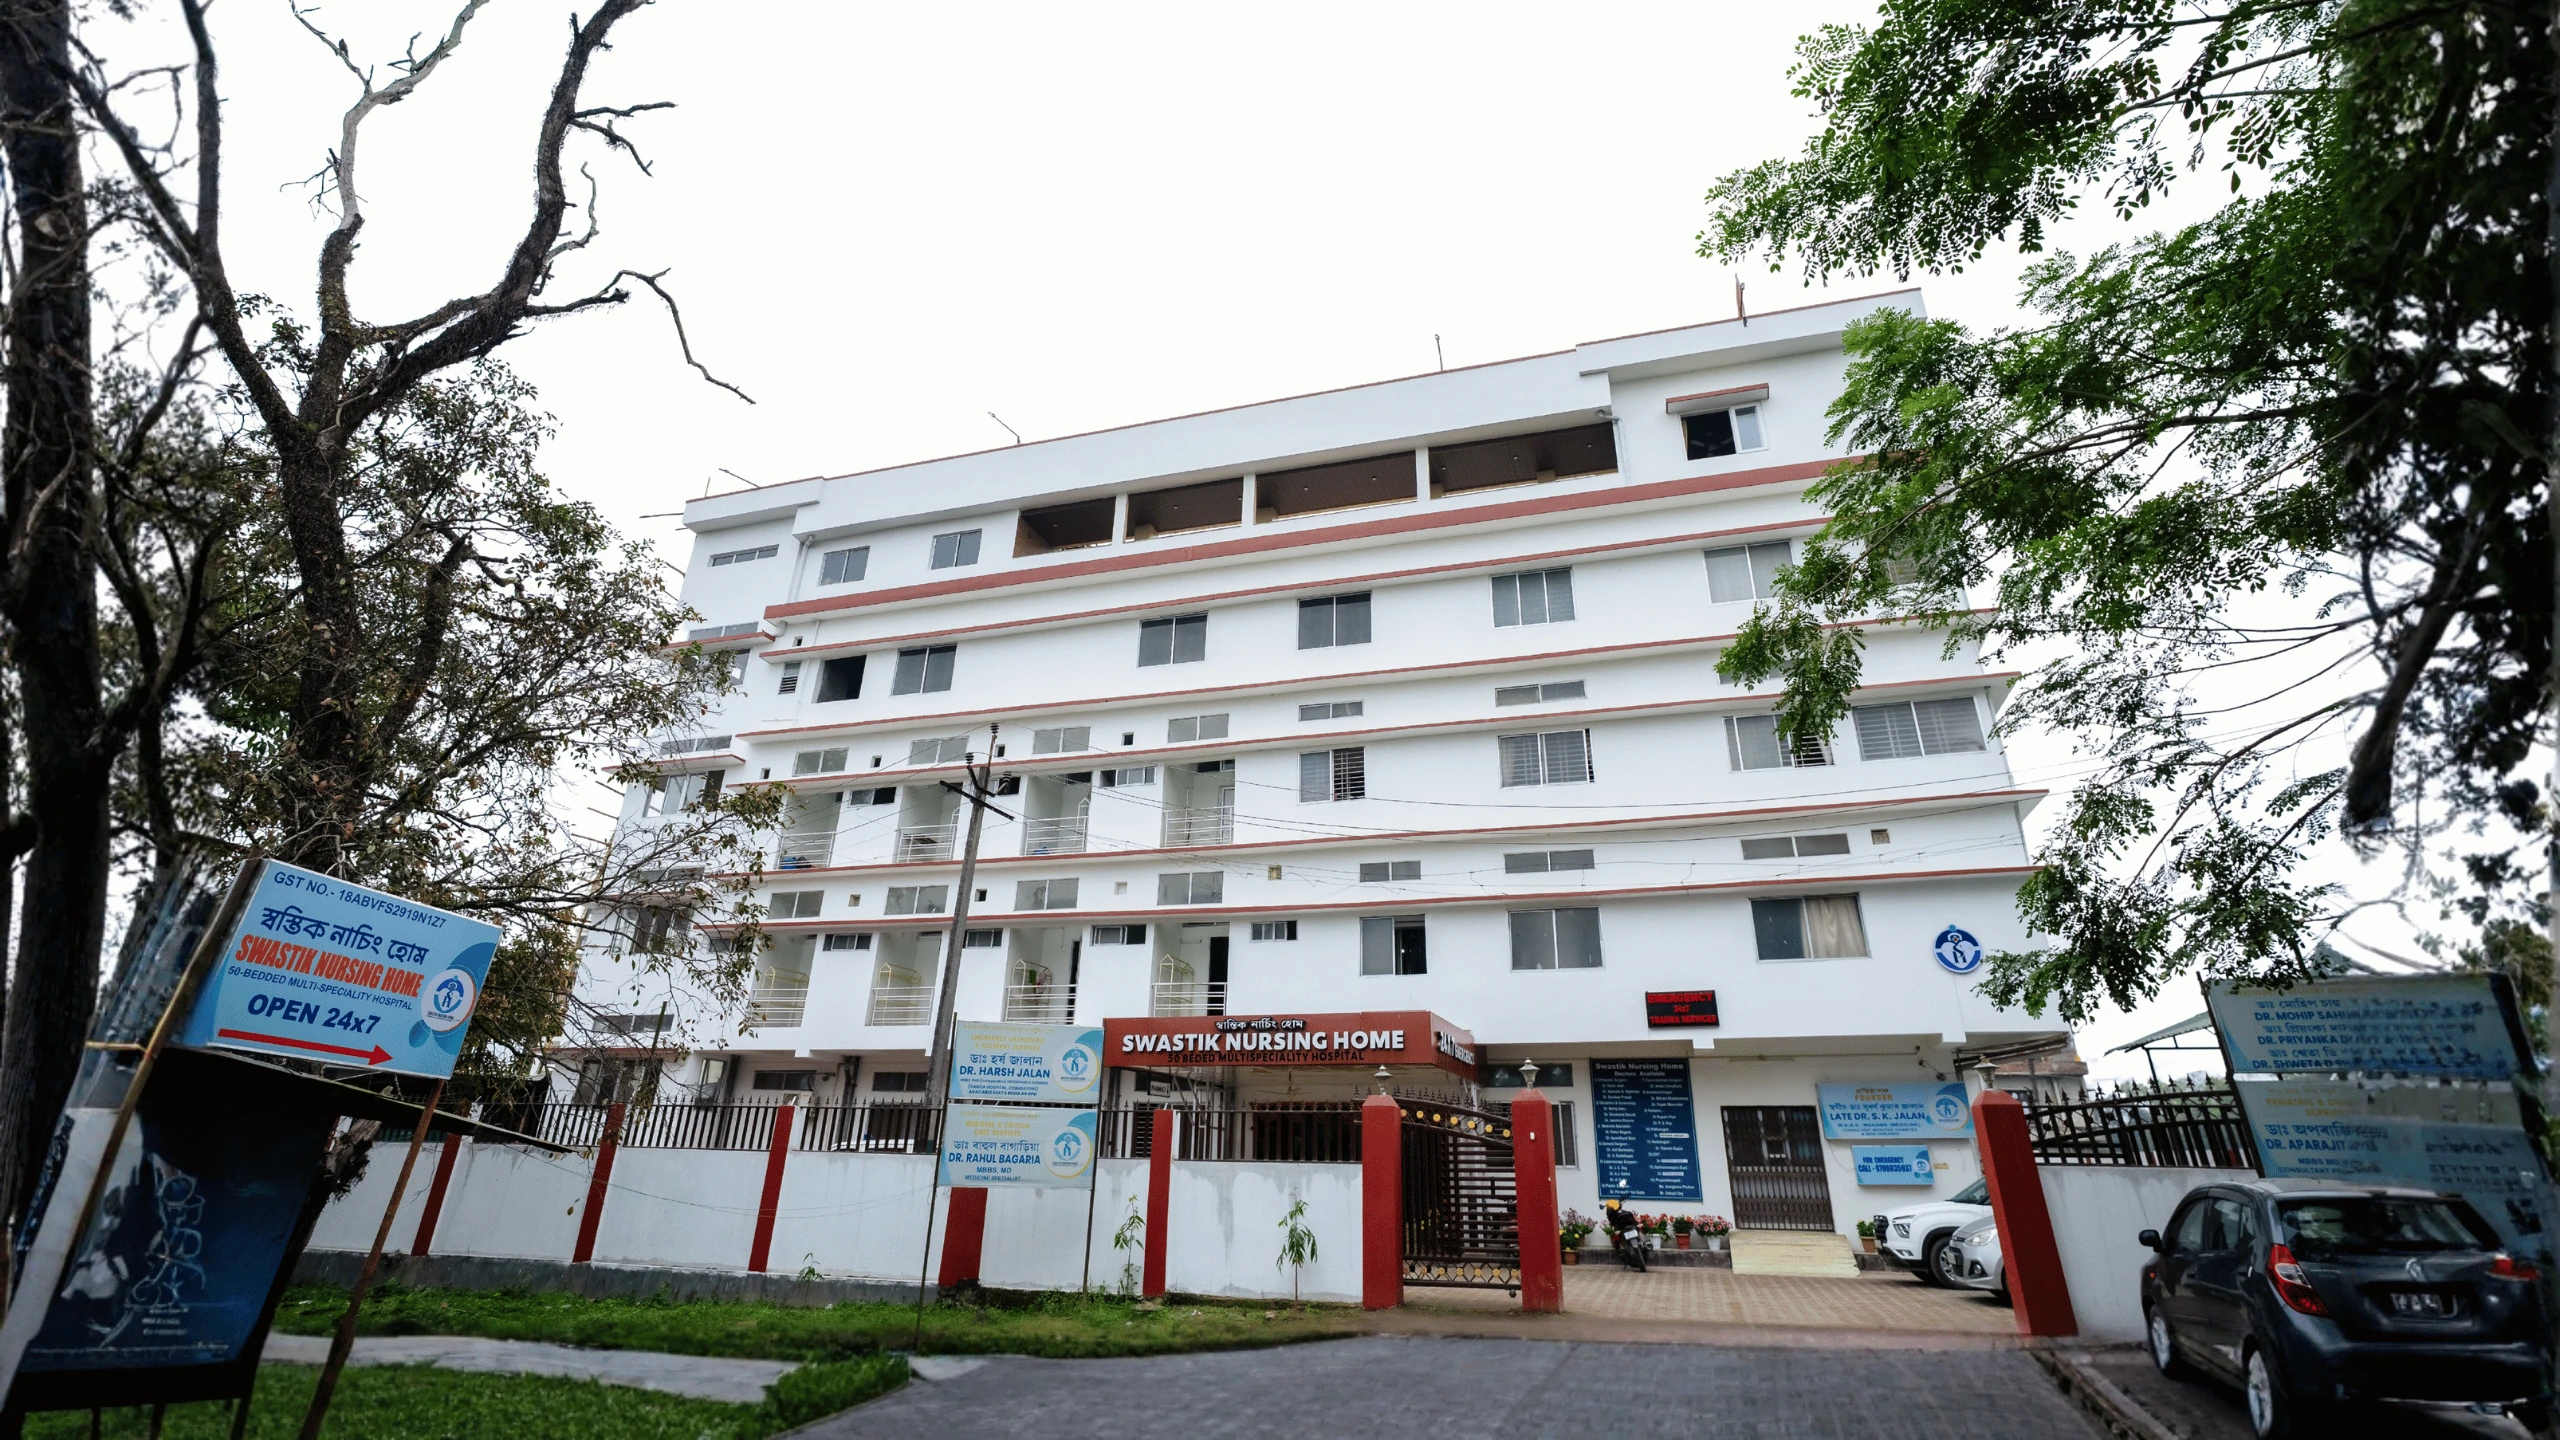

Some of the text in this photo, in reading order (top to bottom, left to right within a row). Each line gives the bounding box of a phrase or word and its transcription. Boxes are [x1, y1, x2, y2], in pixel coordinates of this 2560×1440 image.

[274, 871, 305, 888] GST
[339, 889, 447, 929] 18ABVFS2919N1Z7
[388, 939, 430, 966] হোম
[235, 934, 425, 998] SWASTIK NURSING HOME
[228, 965, 413, 1011] 50-BEDDED MULTI-SPECIALITY HOSPITAL
[1647, 991, 1713, 1004] EMERGENCY
[247, 993, 381, 1035] OPEN 24x7
[1681, 1014, 1717, 1023] SERVICES
[2254, 1011, 2275, 1021] DR.
[1281, 1018, 1304, 1029] হোম
[1121, 1030, 1405, 1053] SWASTIK NURSING HOME
[2257, 1035, 2278, 1045] DR.
[2278, 1035, 2339, 1044] PRIYANKA
[1168, 1053, 1181, 1063] 50
[1218, 1051, 1309, 1063] MULTISPECIALITY
[1311, 1050, 1365, 1062] HOSPITAL
[1595, 1062, 1627, 1070] Swastik
[1628, 1063, 1659, 1071] Nursing
[2252, 1060, 2272, 1069] DR.
[2273, 1059, 2322, 1069] SHWETA
[959, 1065, 976, 1076] DR.
[979, 1066, 1015, 1077] HARSH
[1017, 1068, 1051, 1079] JALAN
[1829, 1112, 1852, 1120] LATE
[1854, 1112, 1870, 1120] DR.
[1894, 1112, 1925, 1120] JALAN
[2265, 1139, 2287, 1150] DR.
[949, 1152, 964, 1163] DR.
[966, 1153, 997, 1163] RAHUL
[999, 1154, 1041, 1165] BAGARIA
[1858, 1164, 1871, 1172] CALL
